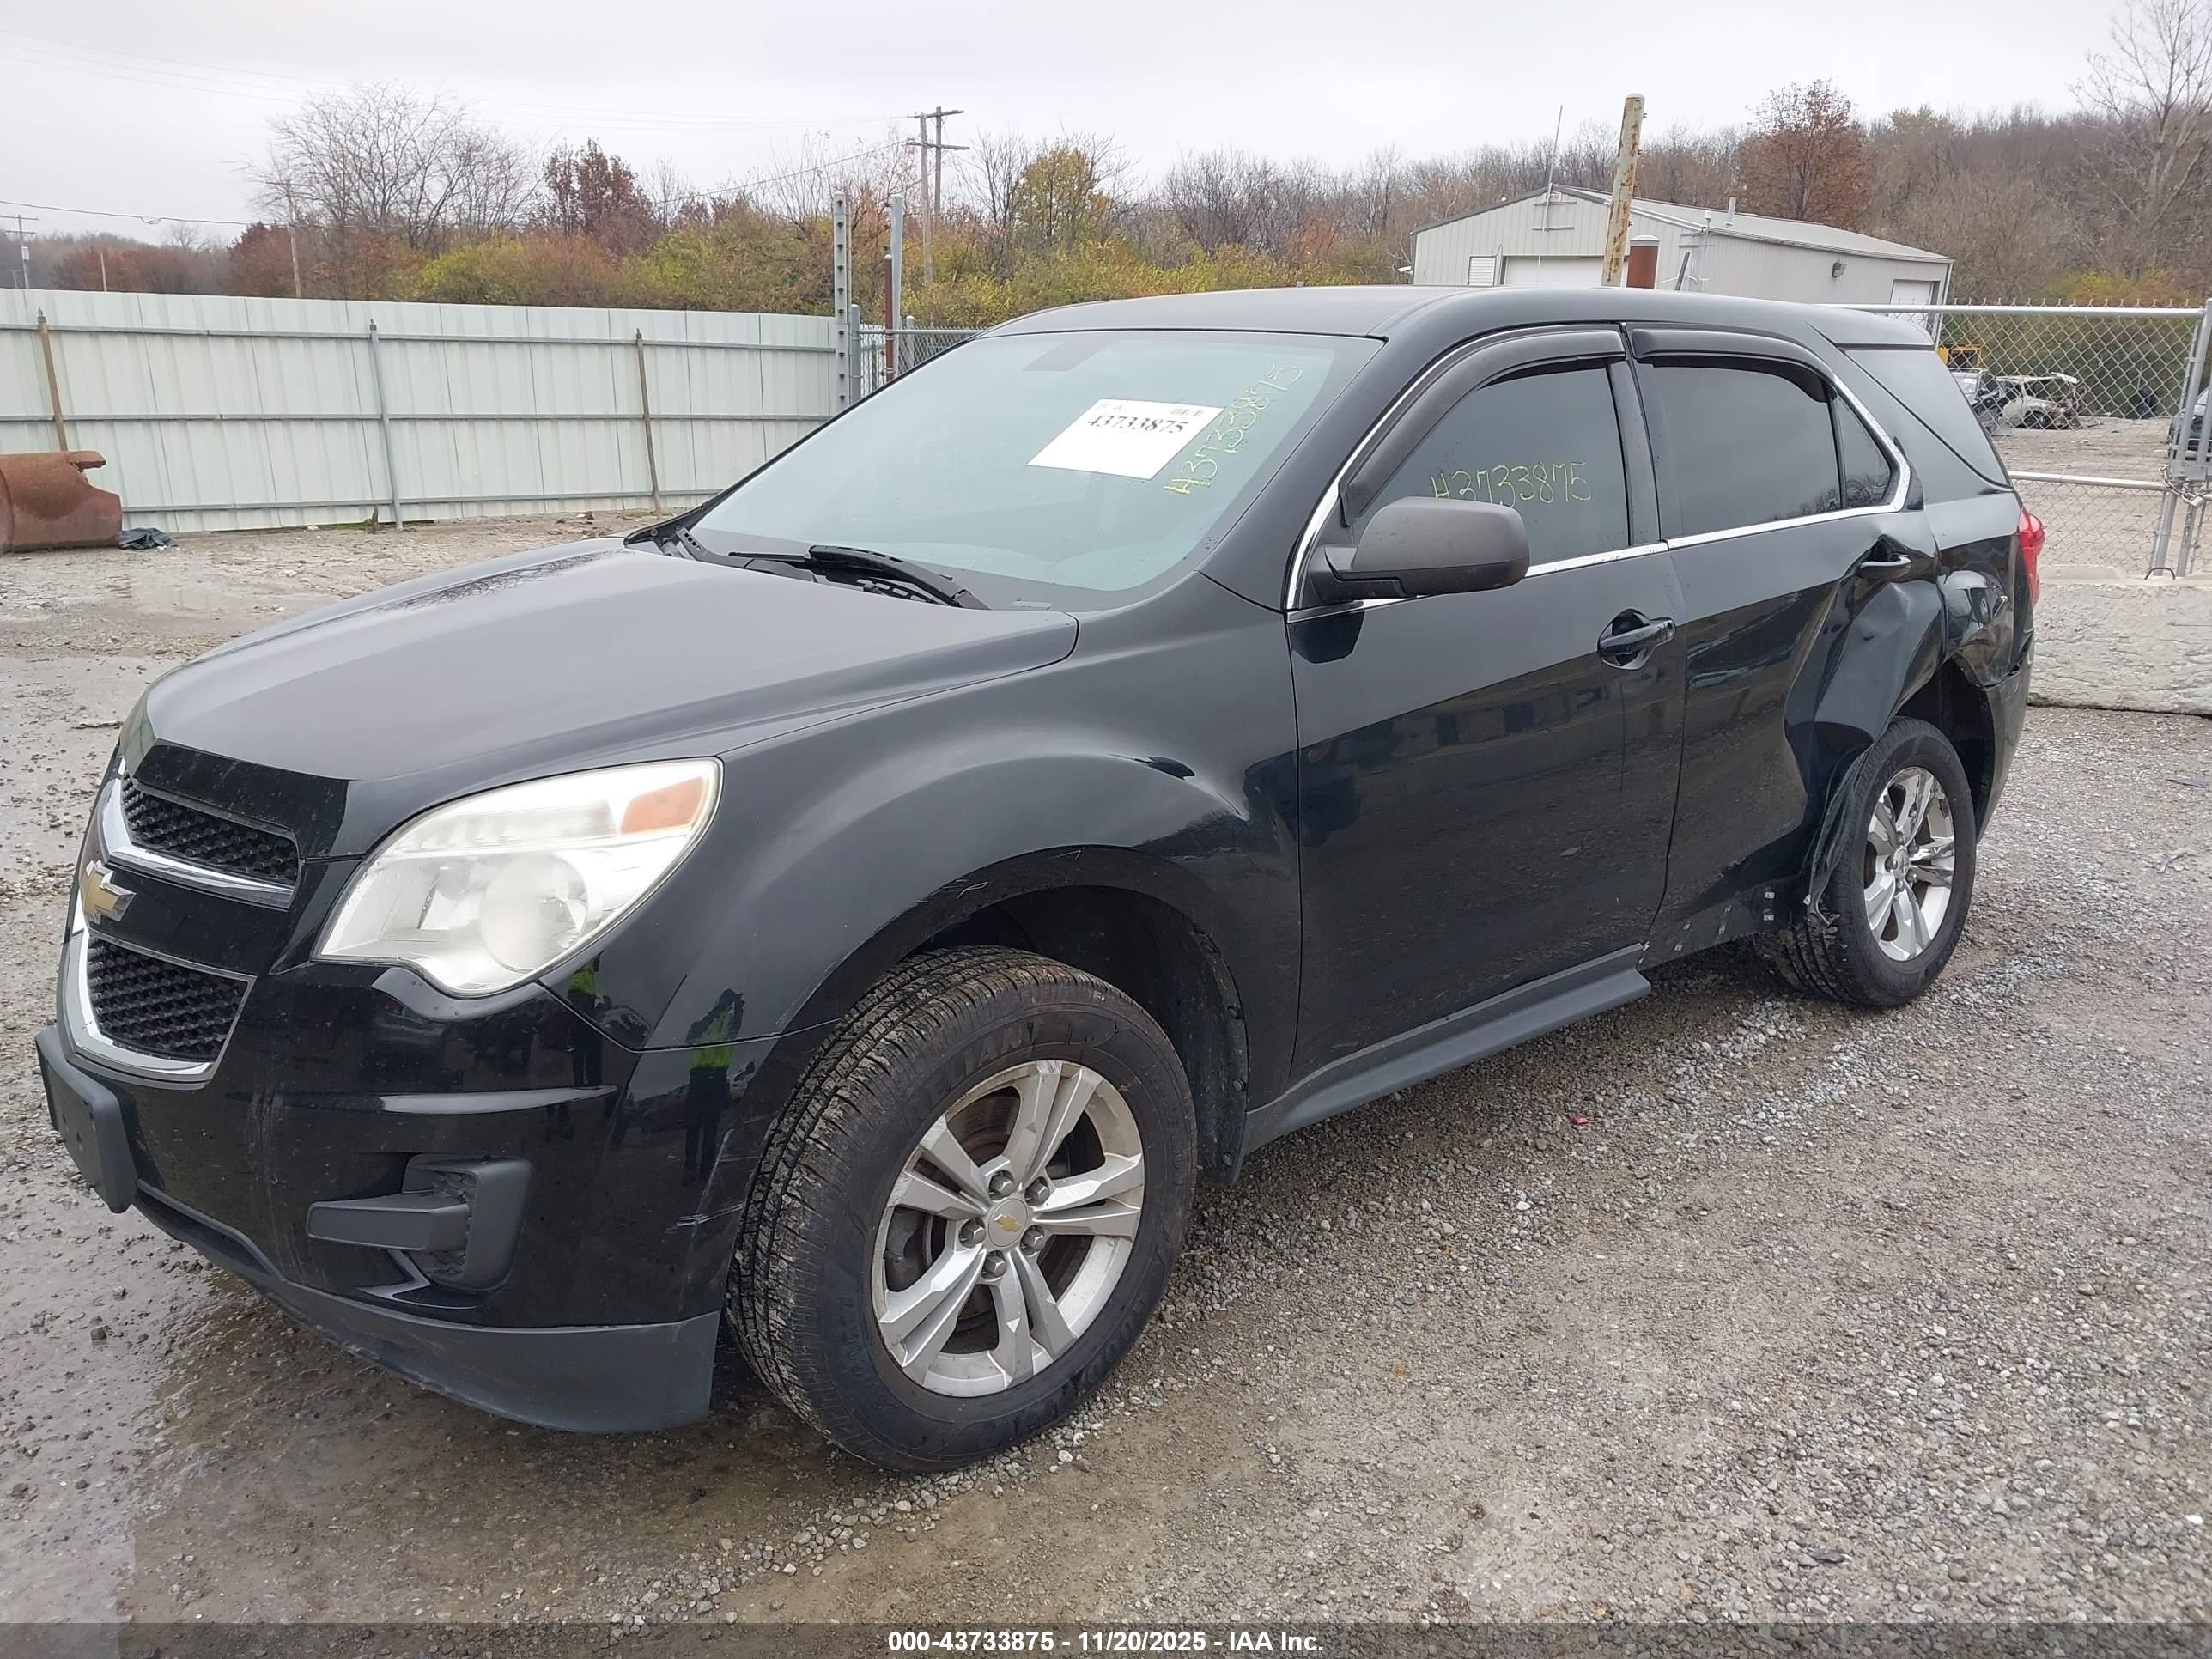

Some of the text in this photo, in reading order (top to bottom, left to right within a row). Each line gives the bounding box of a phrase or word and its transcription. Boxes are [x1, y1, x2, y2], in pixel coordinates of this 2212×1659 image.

[1088, 414, 1189, 434] 43733875
[1164, 362, 1304, 495] 43733875
[1431, 460, 1592, 508] 43733875
